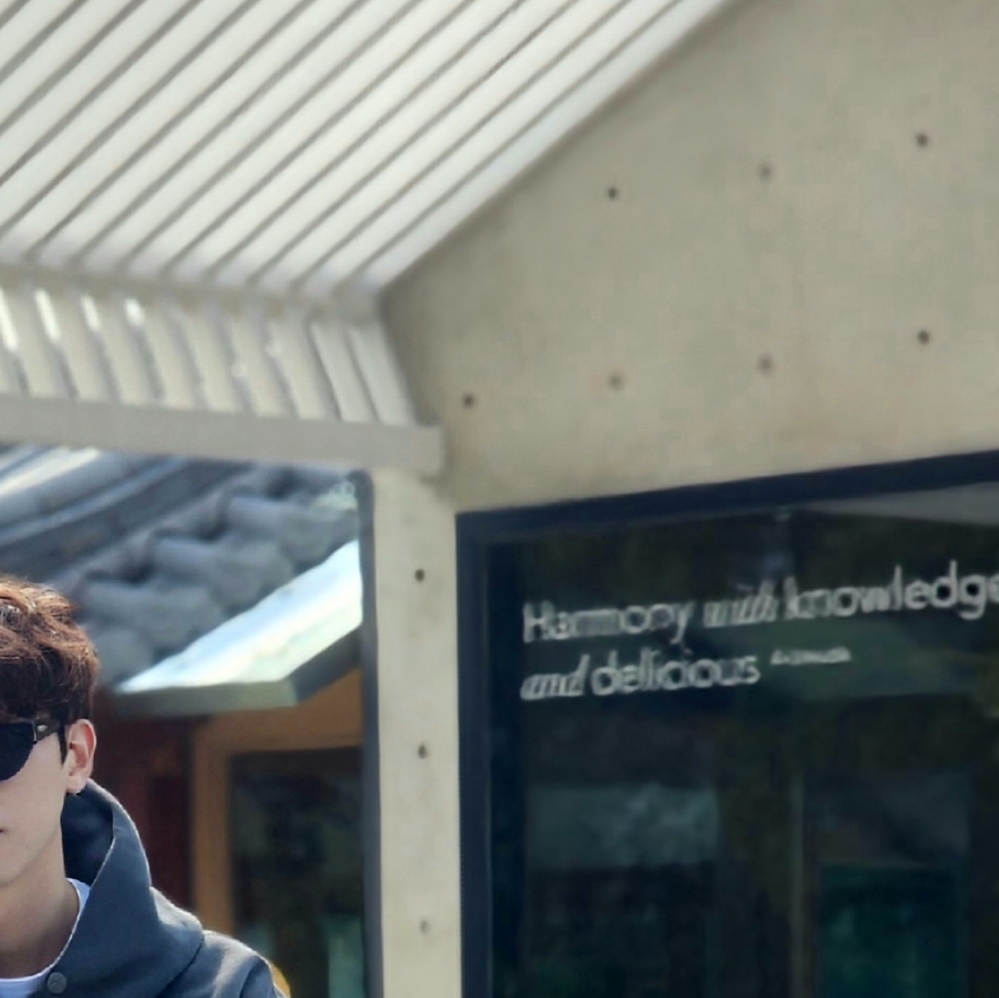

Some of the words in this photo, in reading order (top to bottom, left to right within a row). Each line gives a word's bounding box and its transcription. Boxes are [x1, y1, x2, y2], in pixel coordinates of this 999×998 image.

[522, 600, 694, 645] Harmony
[520, 653, 590, 700] and
[591, 648, 761, 696] delicious
